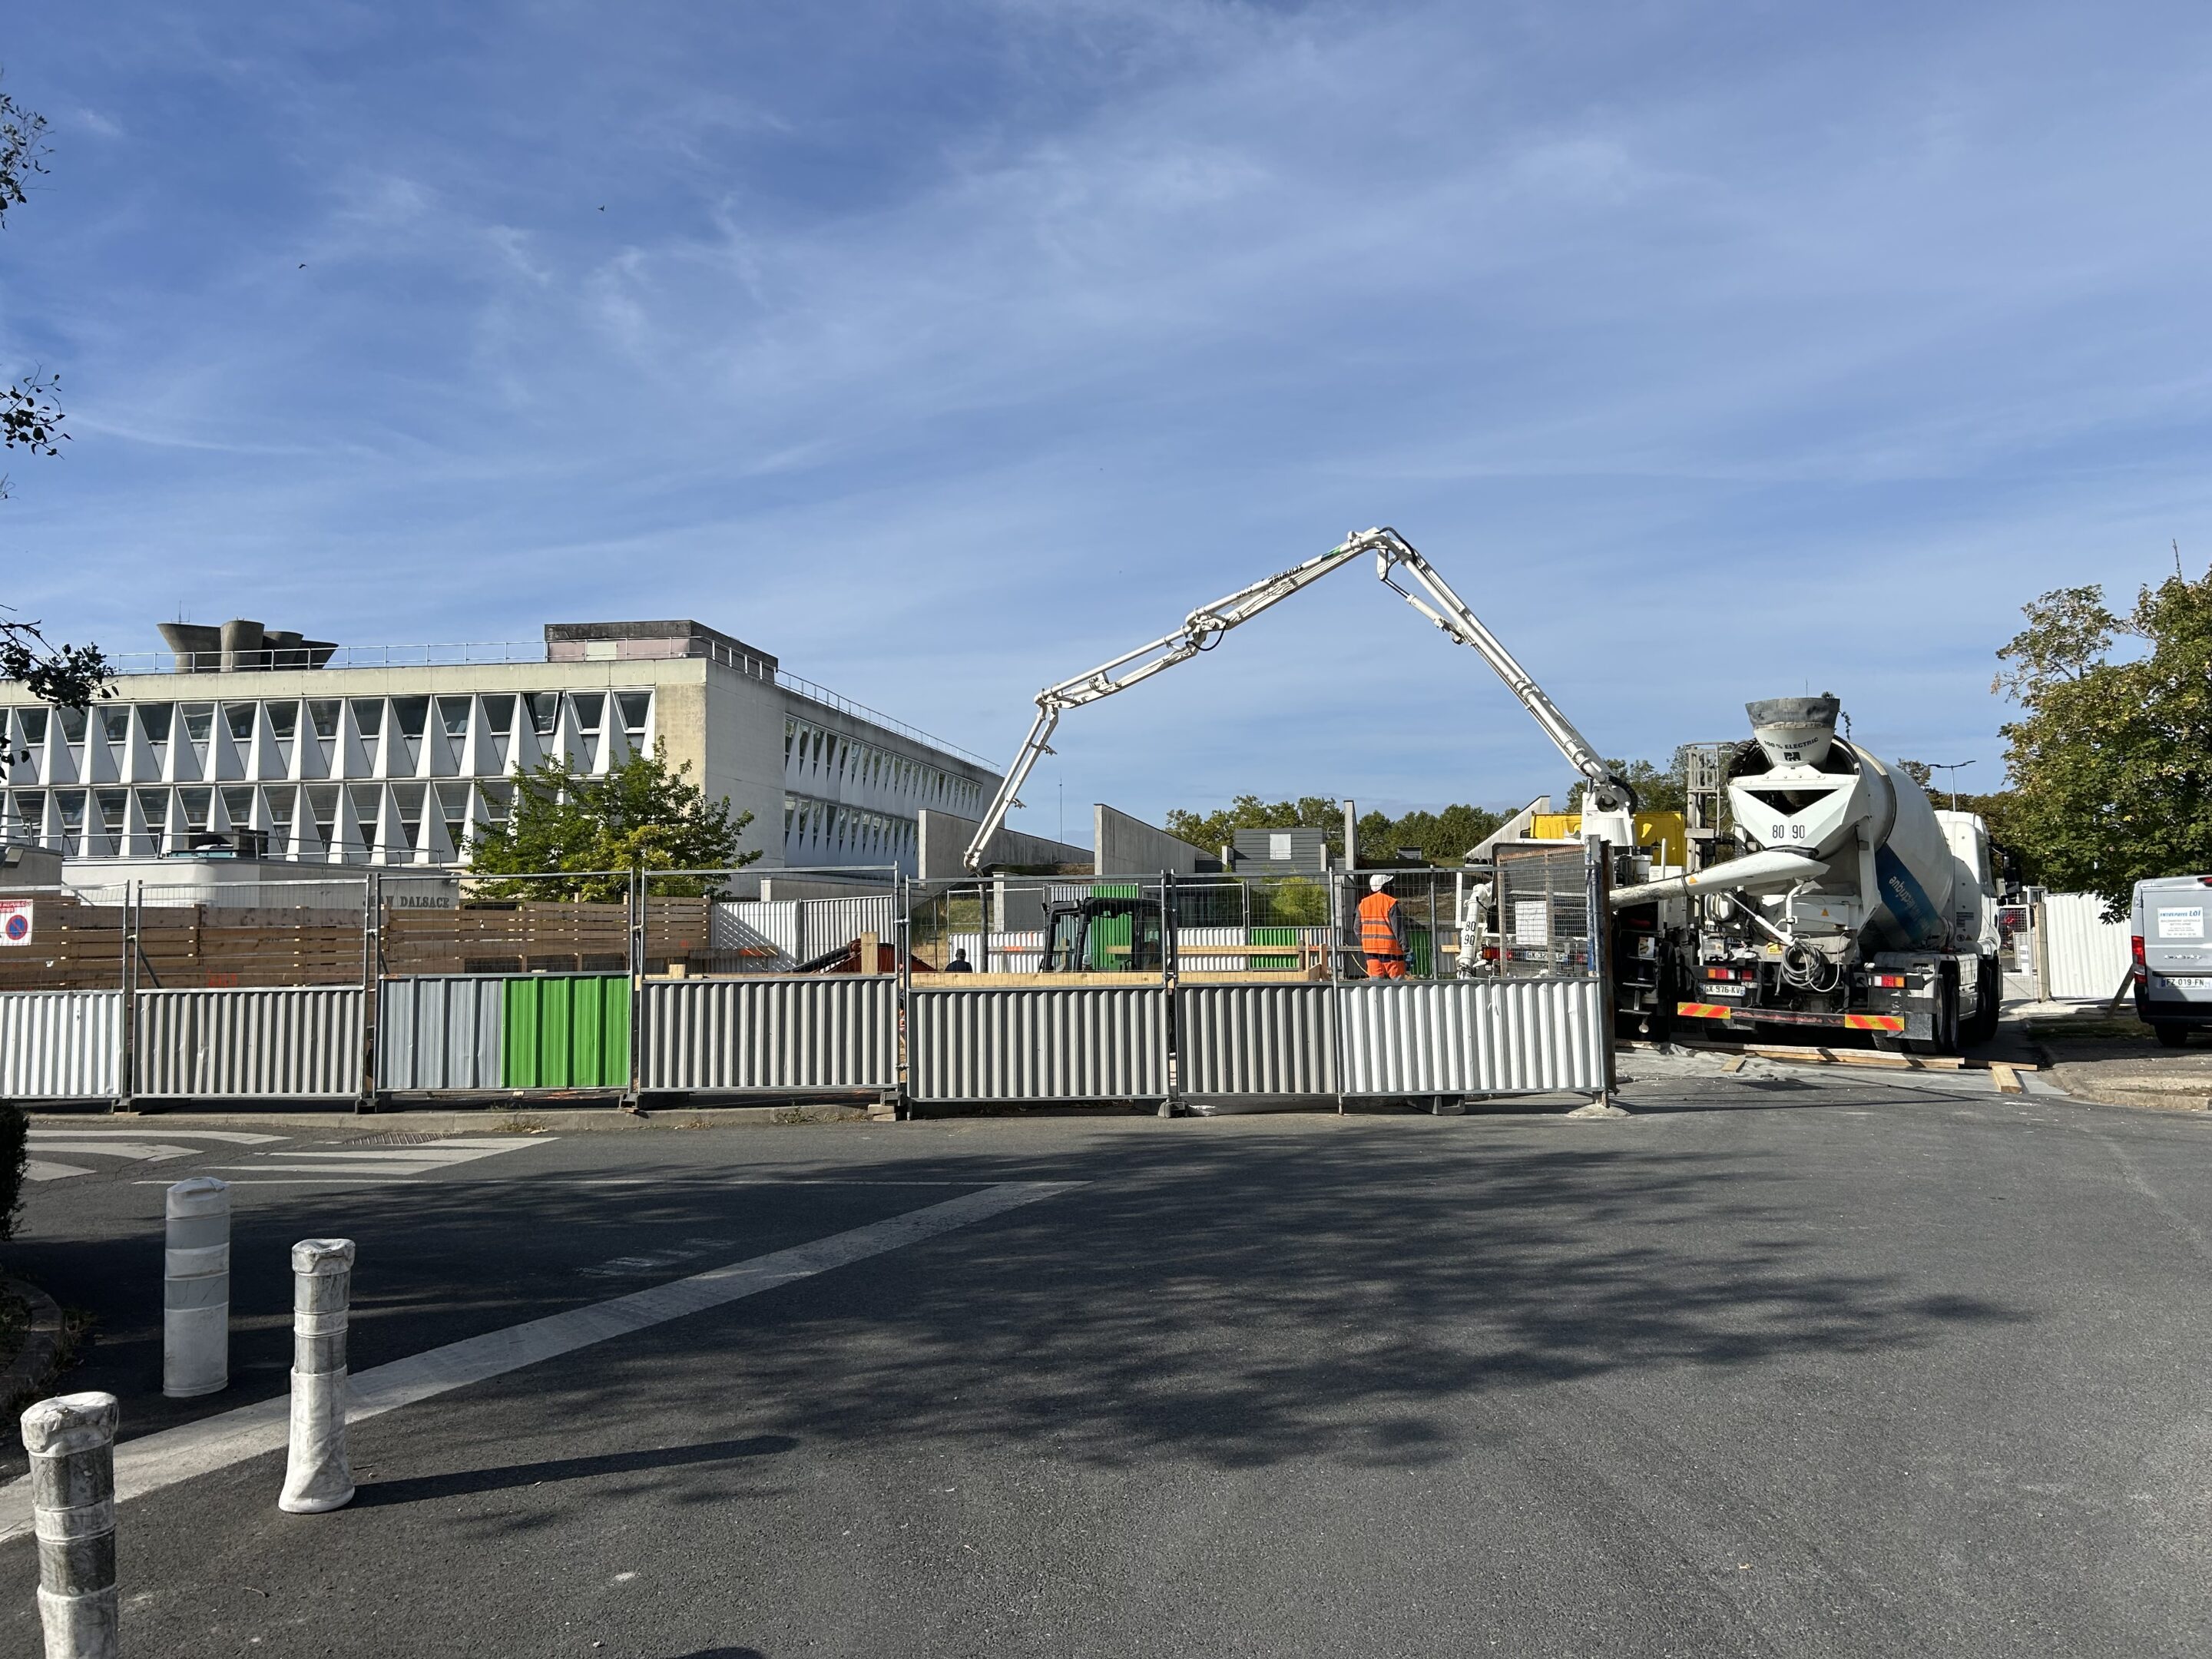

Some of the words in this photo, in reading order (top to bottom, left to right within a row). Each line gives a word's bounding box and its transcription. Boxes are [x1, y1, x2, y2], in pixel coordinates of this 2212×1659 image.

[1763, 740, 1775, 748] 100
[1784, 737, 1819, 750] ELECTRIC
[1772, 824, 1784, 839] 80
[1792, 824, 1805, 839] 90
[400, 896, 449, 908] DALSACE
[1465, 921, 1476, 932] 80
[1464, 934, 1475, 945] 90
[1704, 985, 1740, 994] GX-976-KV
